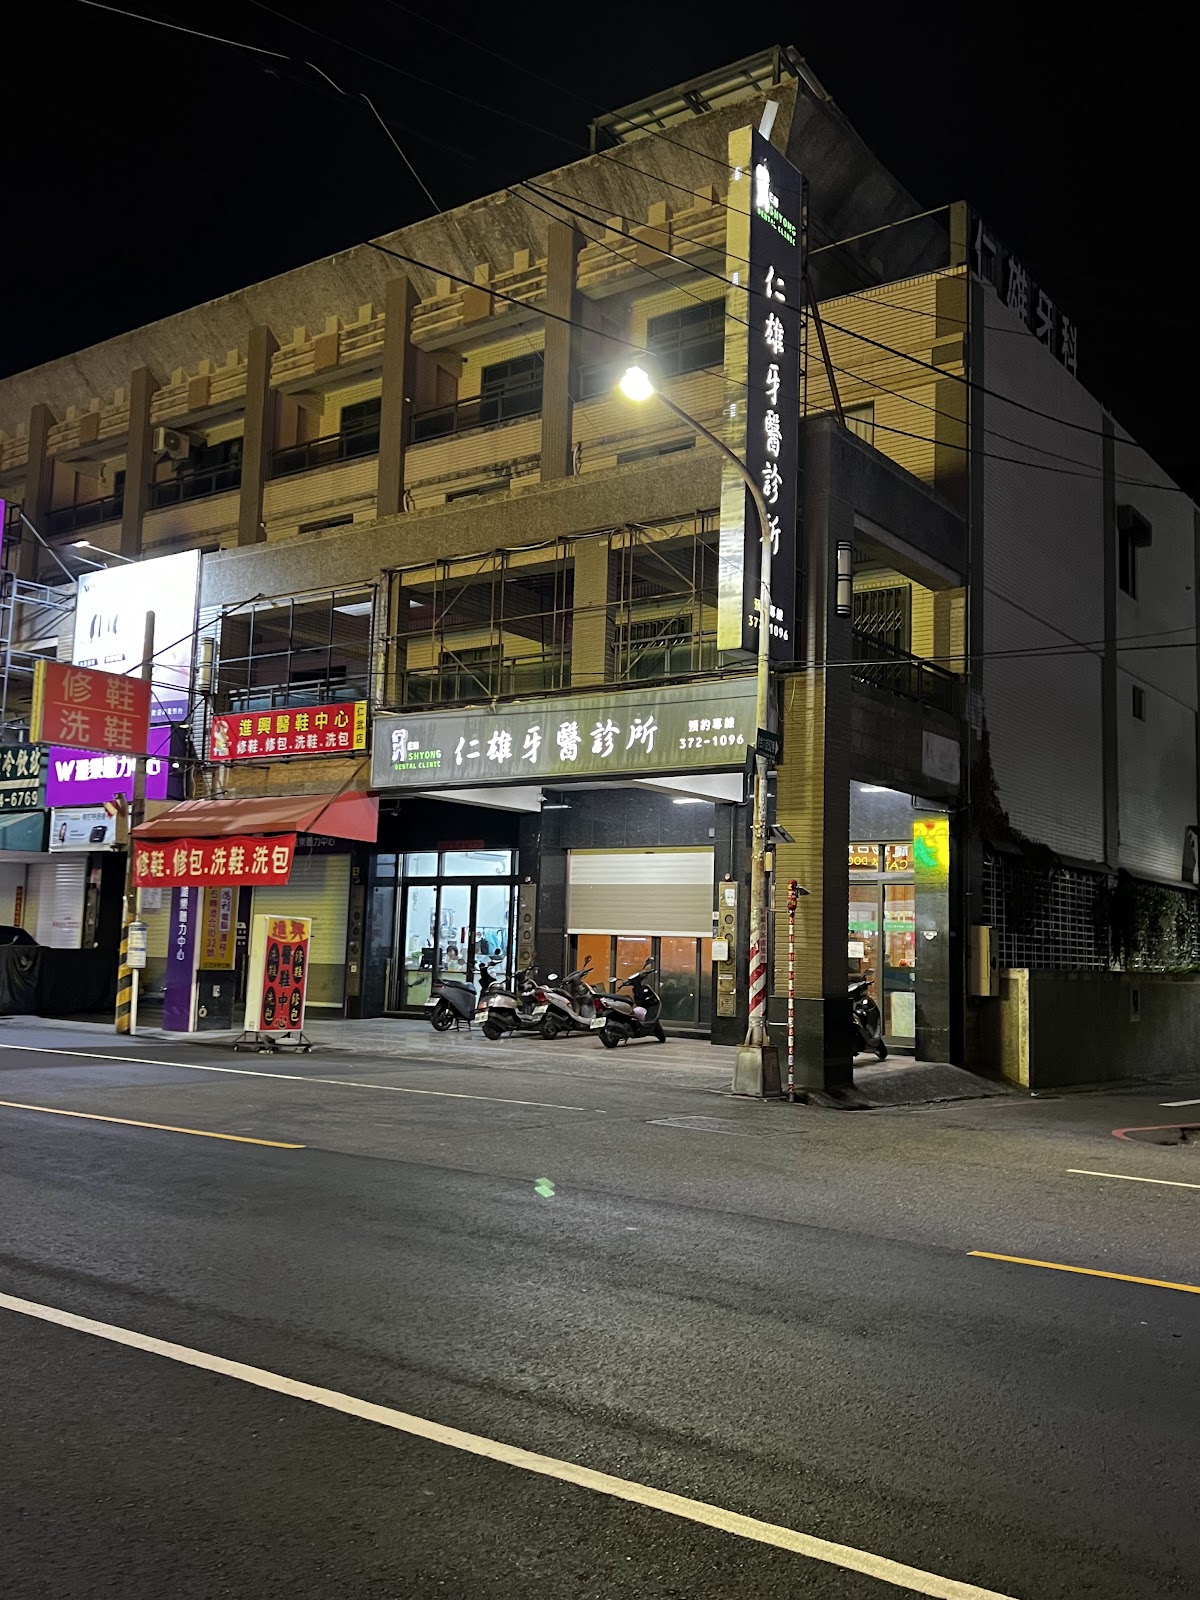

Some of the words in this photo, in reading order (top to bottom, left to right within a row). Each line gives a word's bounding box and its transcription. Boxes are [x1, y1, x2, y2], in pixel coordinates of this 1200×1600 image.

[748, 614, 789, 641] 371096
[62, 669, 134, 711] 修鞋
[59, 708, 133, 749] 洗鞋
[238, 710, 349, 737] 進興醫鞋中心
[454, 715, 659, 766] 仁雄牙醫診所
[679, 734, 745, 750] 372-1096
[394, 763, 417, 771] DENTAL
[418, 760, 441, 769] CLINIC
[408, 750, 442, 760] SHYONG
[272, 920, 305, 940] 進興
